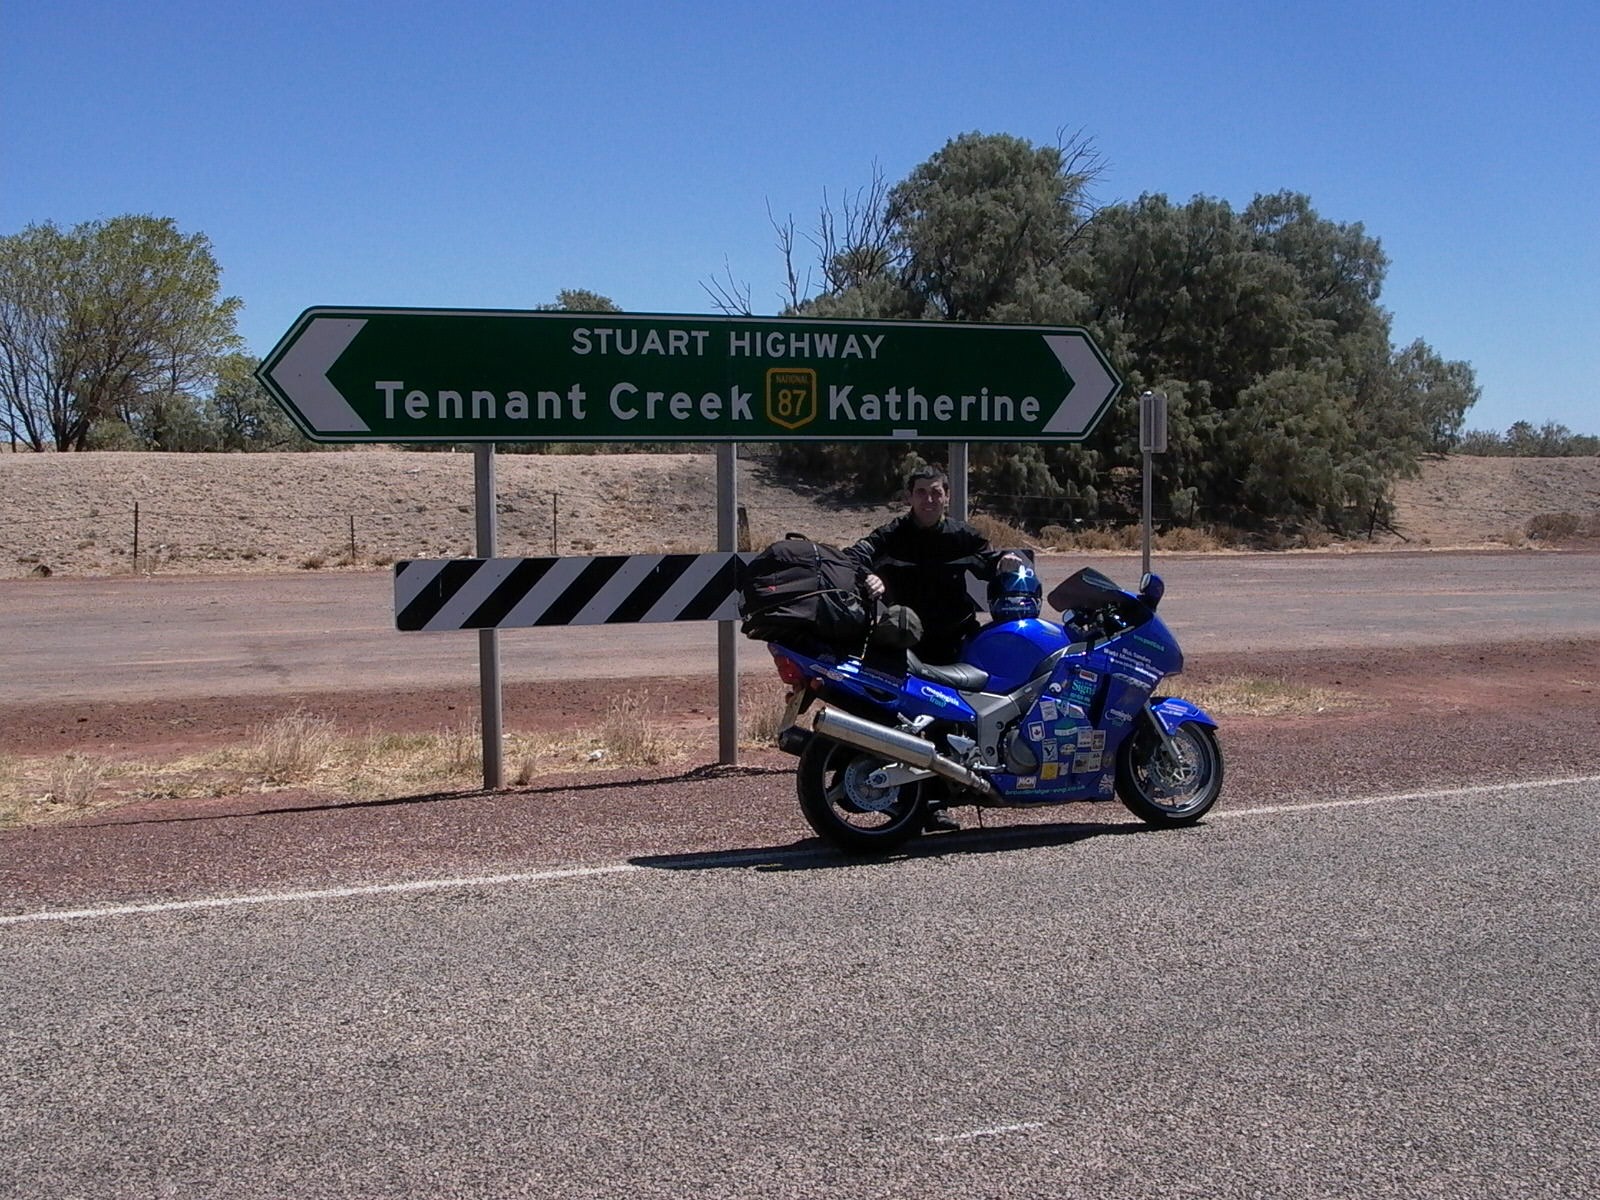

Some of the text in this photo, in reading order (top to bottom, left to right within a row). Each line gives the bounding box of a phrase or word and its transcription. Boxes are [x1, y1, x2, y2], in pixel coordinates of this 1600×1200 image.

[571, 327, 885, 359] STUART HIGHWAY
[775, 374, 809, 385] NATIONAL
[375, 381, 753, 420] Tennant Creek
[779, 388, 806, 416] 87
[829, 385, 1041, 422] Katherine
